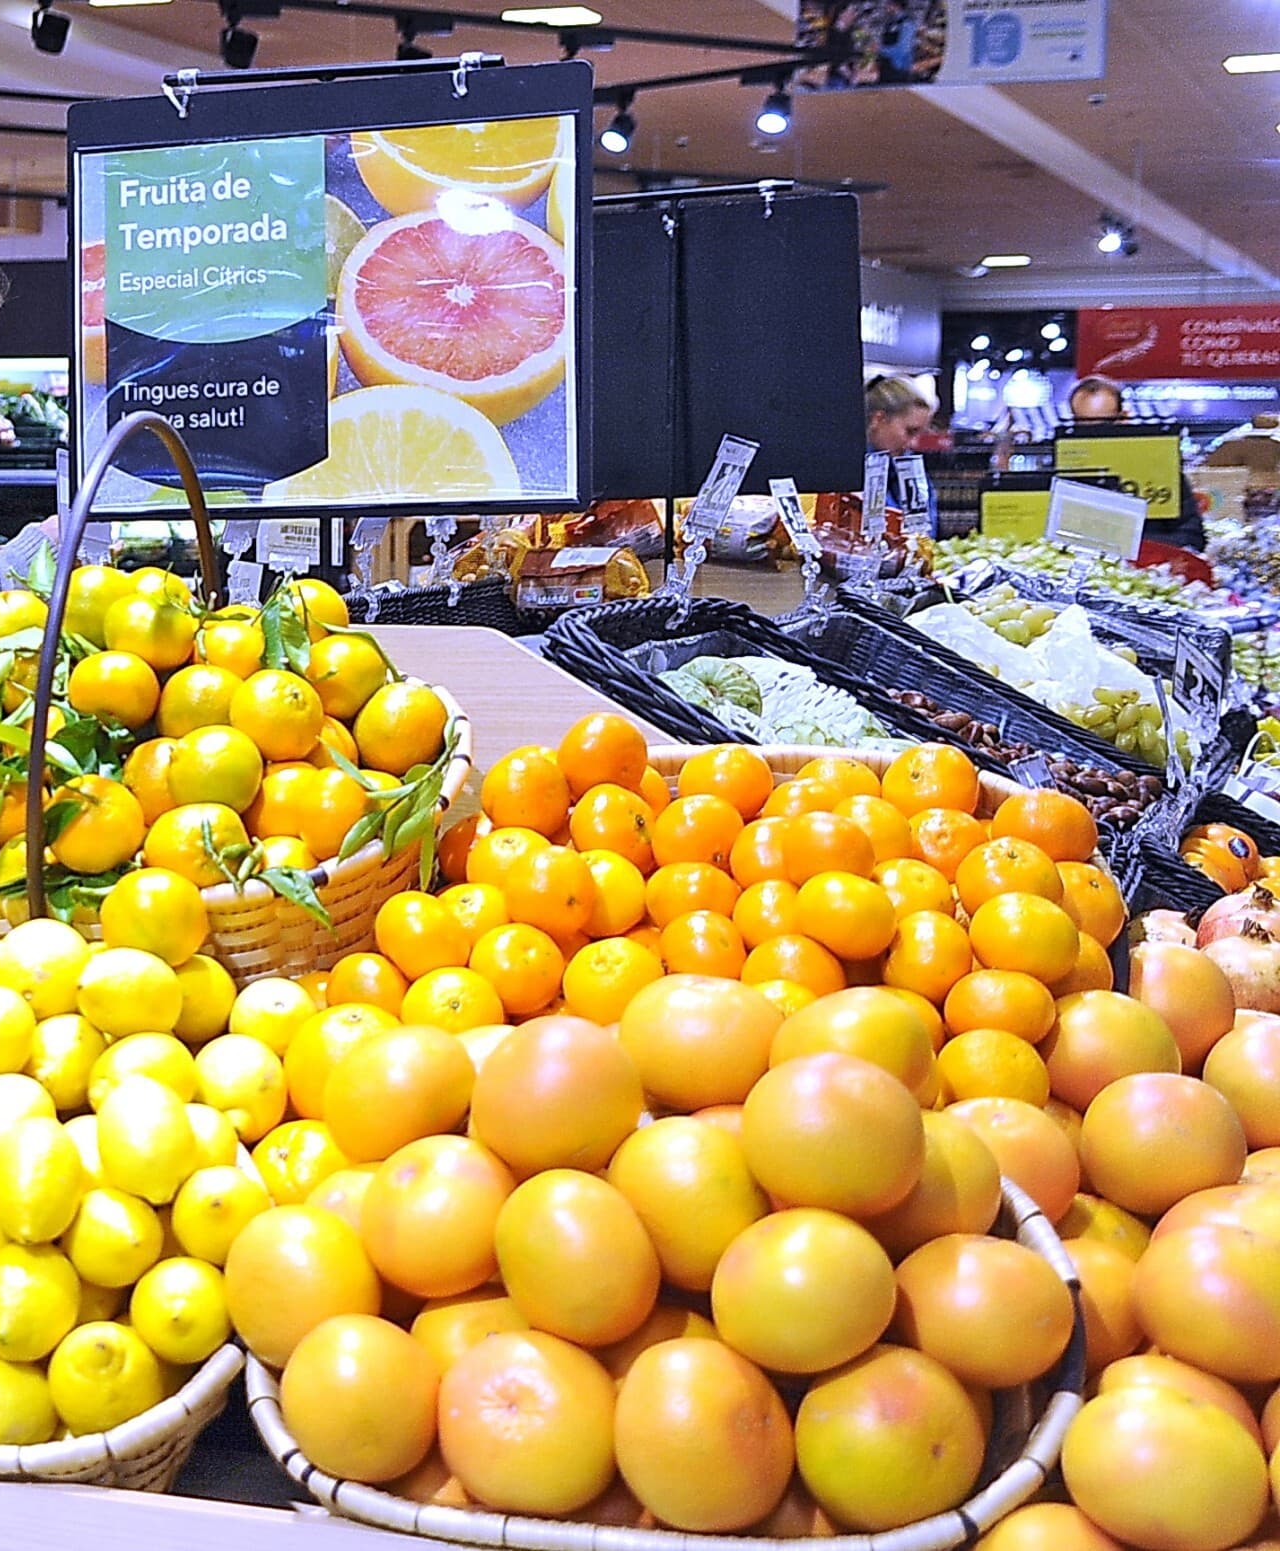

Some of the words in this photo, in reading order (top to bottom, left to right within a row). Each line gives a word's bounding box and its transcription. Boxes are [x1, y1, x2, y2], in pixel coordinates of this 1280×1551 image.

[120, 176, 207, 208] Fruita
[212, 172, 252, 201] de
[118, 213, 288, 254] Temporada
[120, 267, 199, 295] Especial
[203, 264, 268, 287] Cítrics
[1181, 335, 1241, 350] COMO
[121, 382, 200, 405] Tingues
[203, 381, 248, 399] cura
[252, 375, 281, 396] de
[188, 406, 246, 428] salut!
